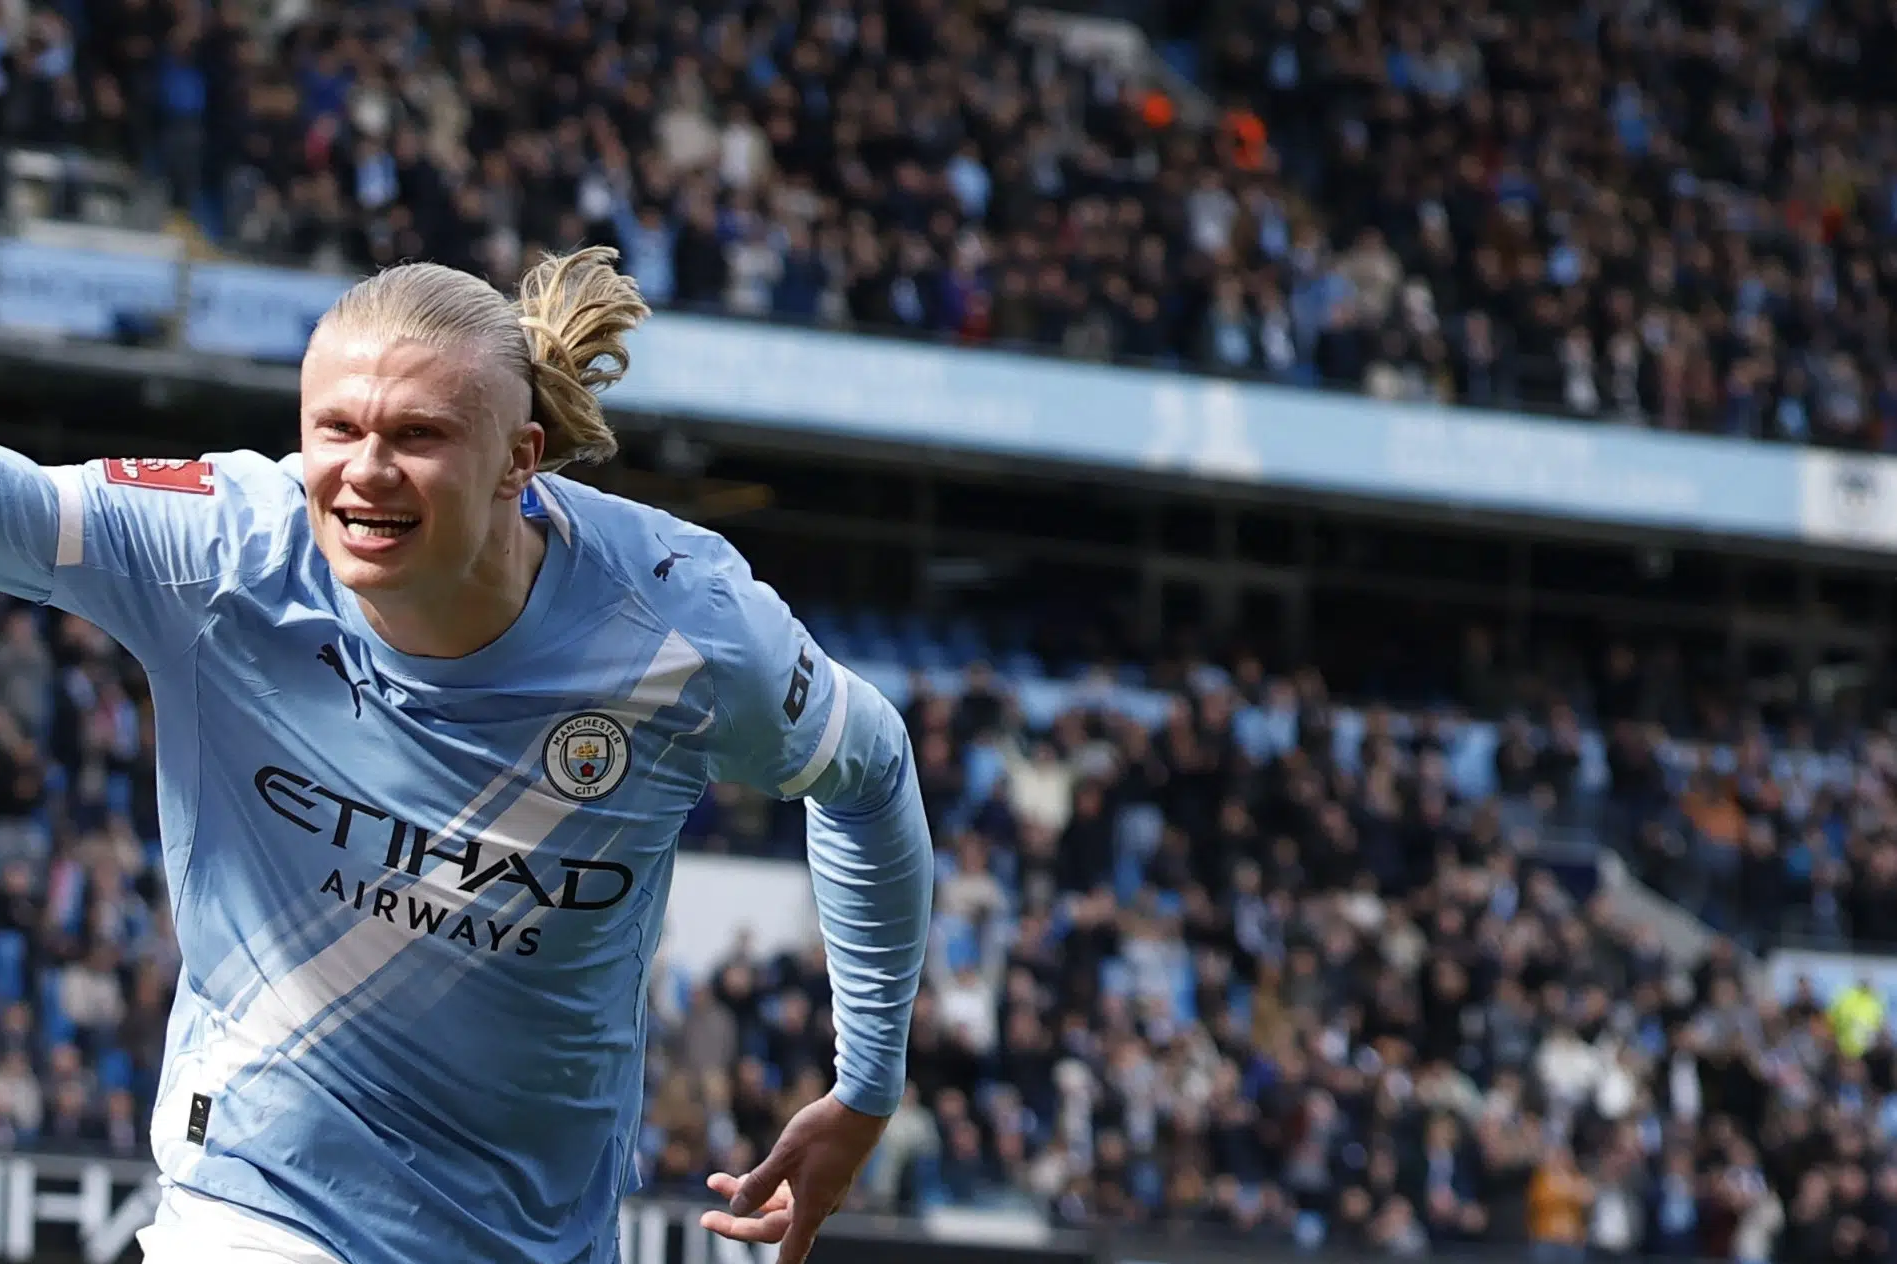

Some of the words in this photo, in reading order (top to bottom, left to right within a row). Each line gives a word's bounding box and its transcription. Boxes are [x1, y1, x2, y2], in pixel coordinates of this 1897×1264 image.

[552, 718, 622, 747] MANCHESTER
[574, 785, 600, 796] CITY
[254, 765, 634, 910] ETIHAD
[320, 868, 541, 957] AIRWAYS
